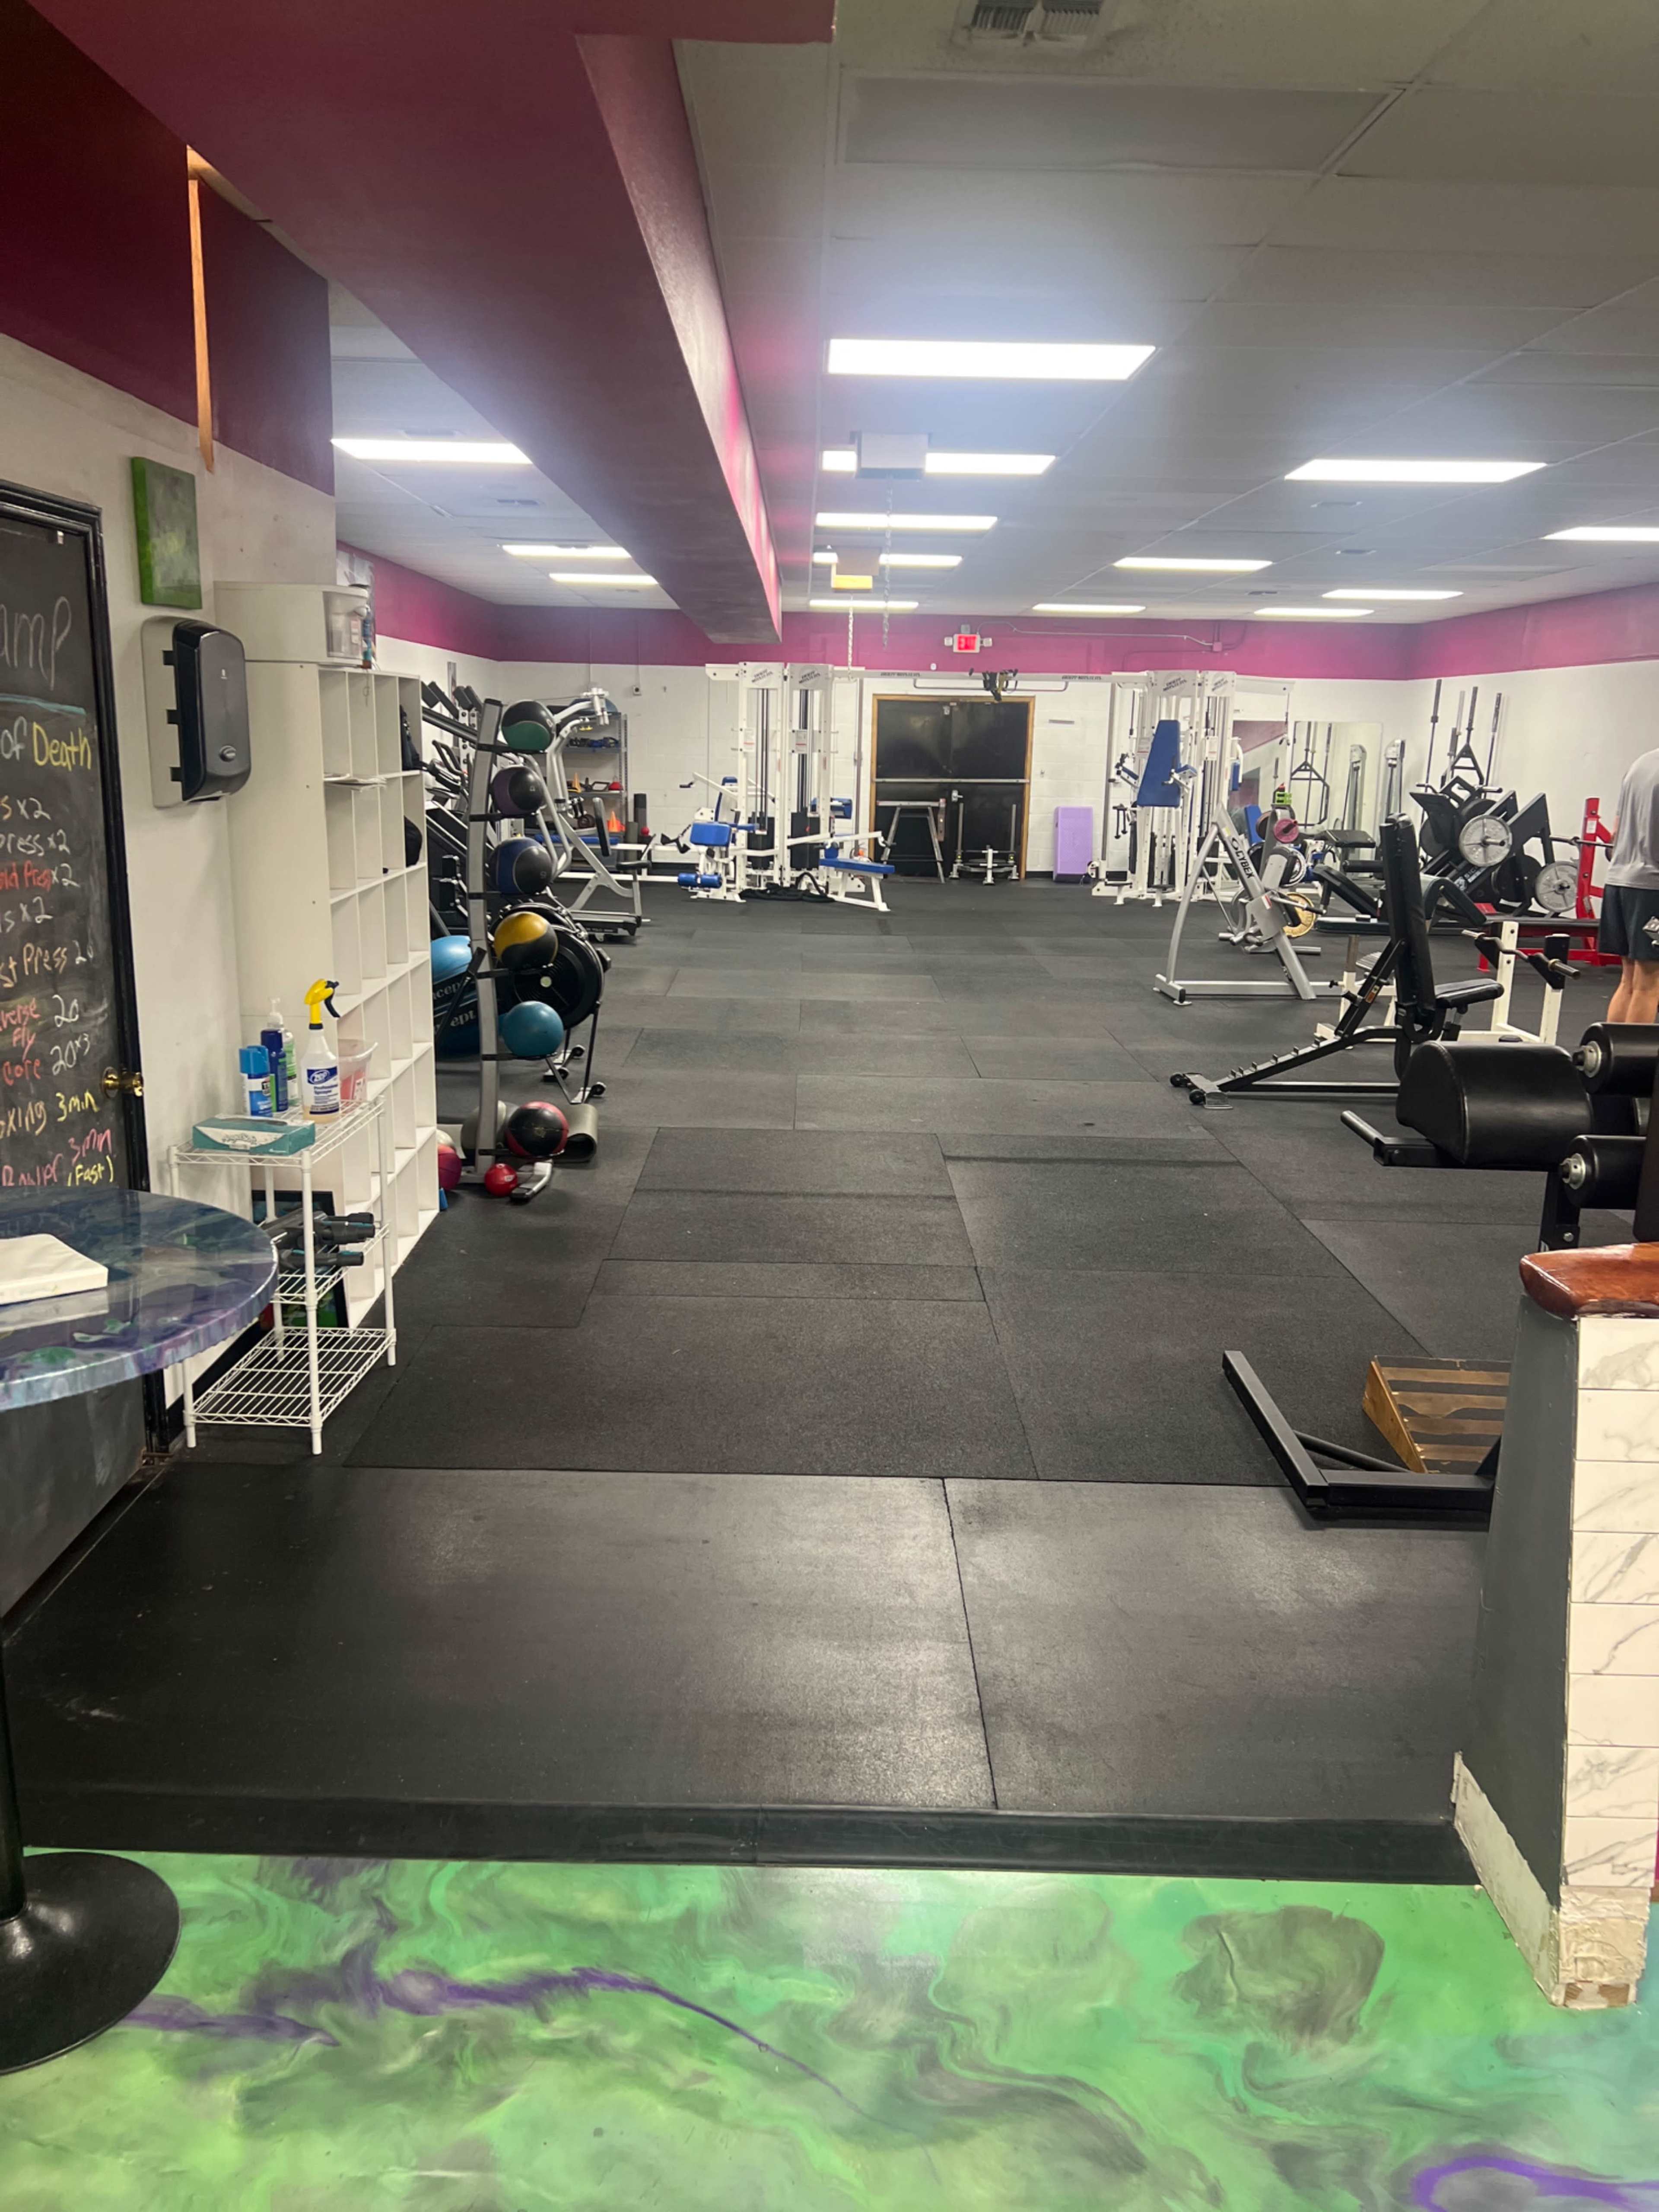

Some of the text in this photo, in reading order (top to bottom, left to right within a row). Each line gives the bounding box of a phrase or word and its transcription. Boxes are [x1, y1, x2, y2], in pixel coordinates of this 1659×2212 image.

[32, 721, 92, 772] Death
[47, 829, 70, 855] x2
[51, 863, 80, 888] x2
[1235, 850, 1255, 879] CYBEX
[19, 896, 53, 924] x2
[23, 942, 67, 975] Press
[0, 995, 79, 1032] verse 20
